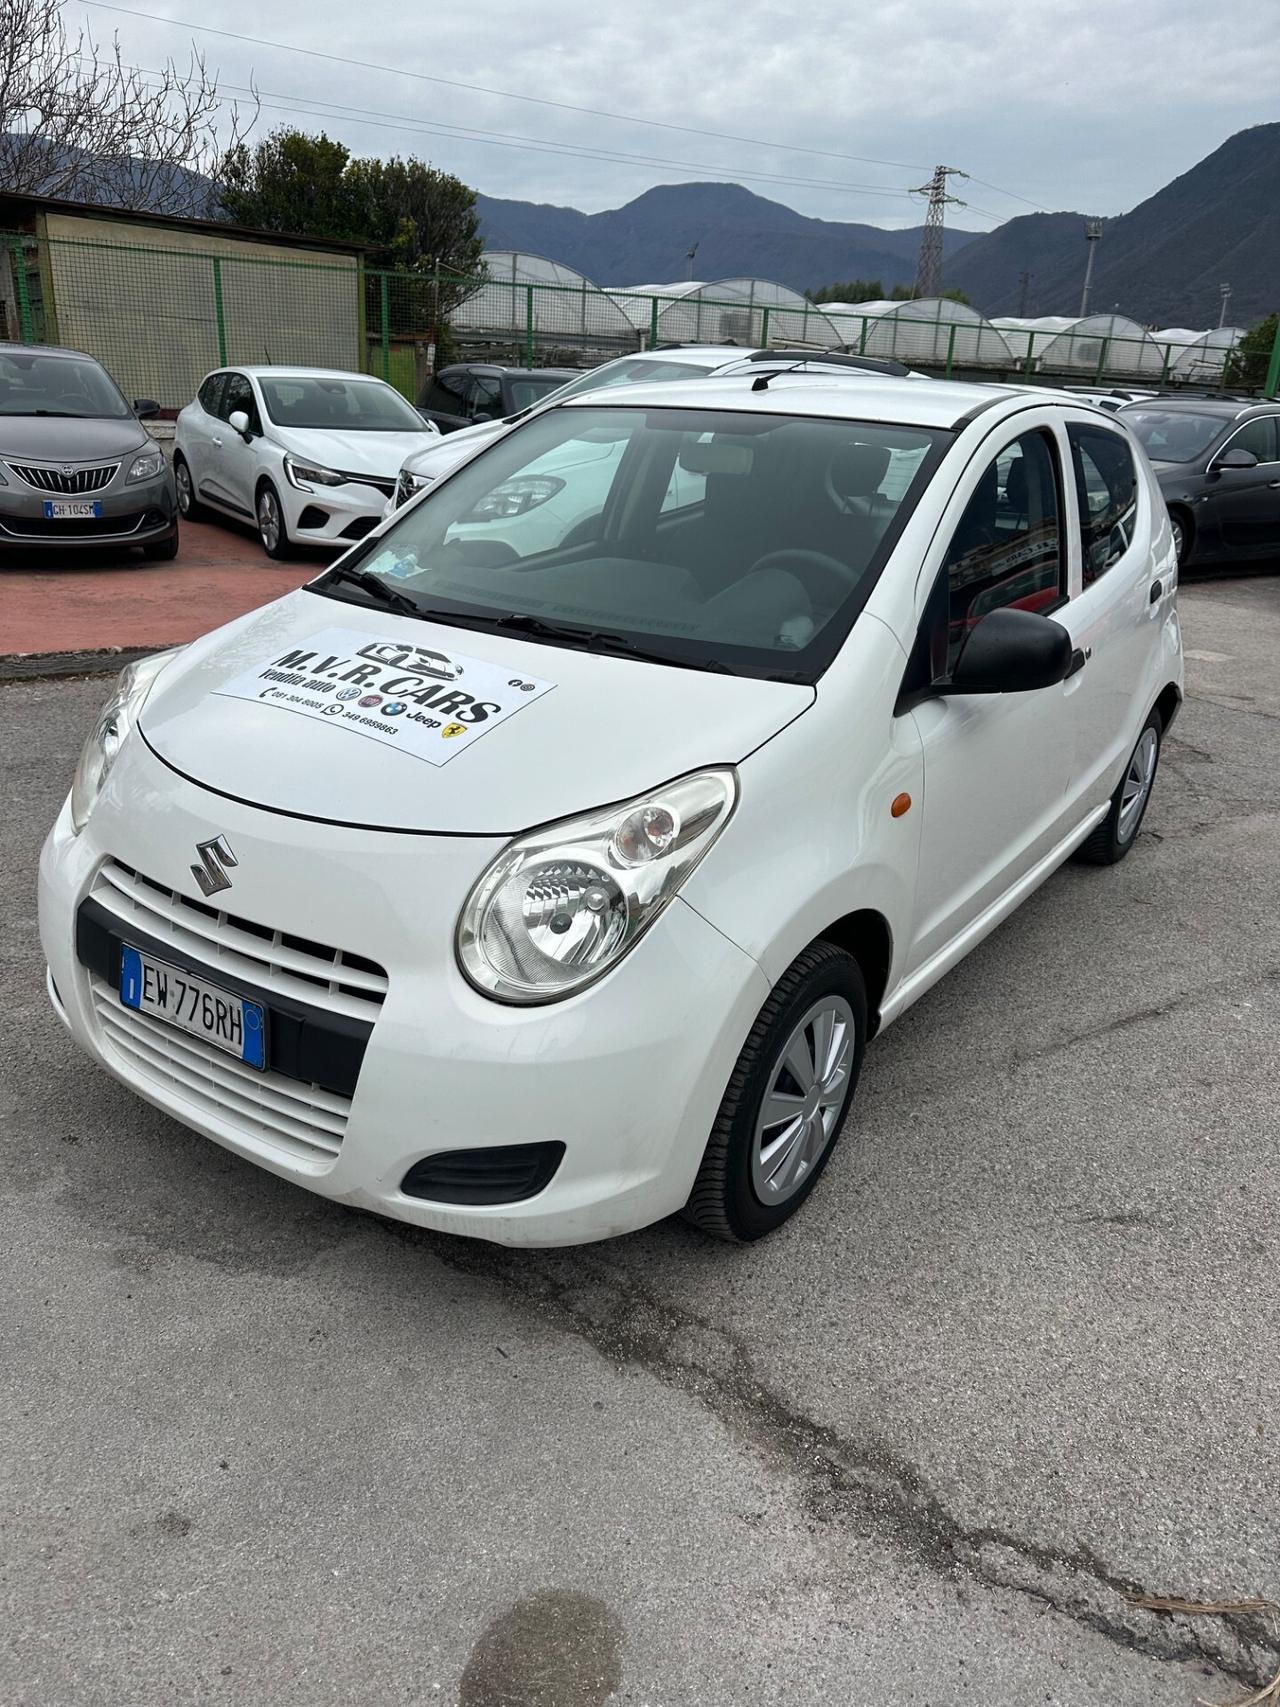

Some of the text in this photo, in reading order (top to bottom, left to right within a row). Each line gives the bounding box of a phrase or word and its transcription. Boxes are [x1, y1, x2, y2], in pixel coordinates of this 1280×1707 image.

[258, 668, 337, 693] Vendita auto
[379, 676, 502, 723] CARS
[342, 711, 399, 735] 349 6959863
[406, 711, 442, 729] Jeep
